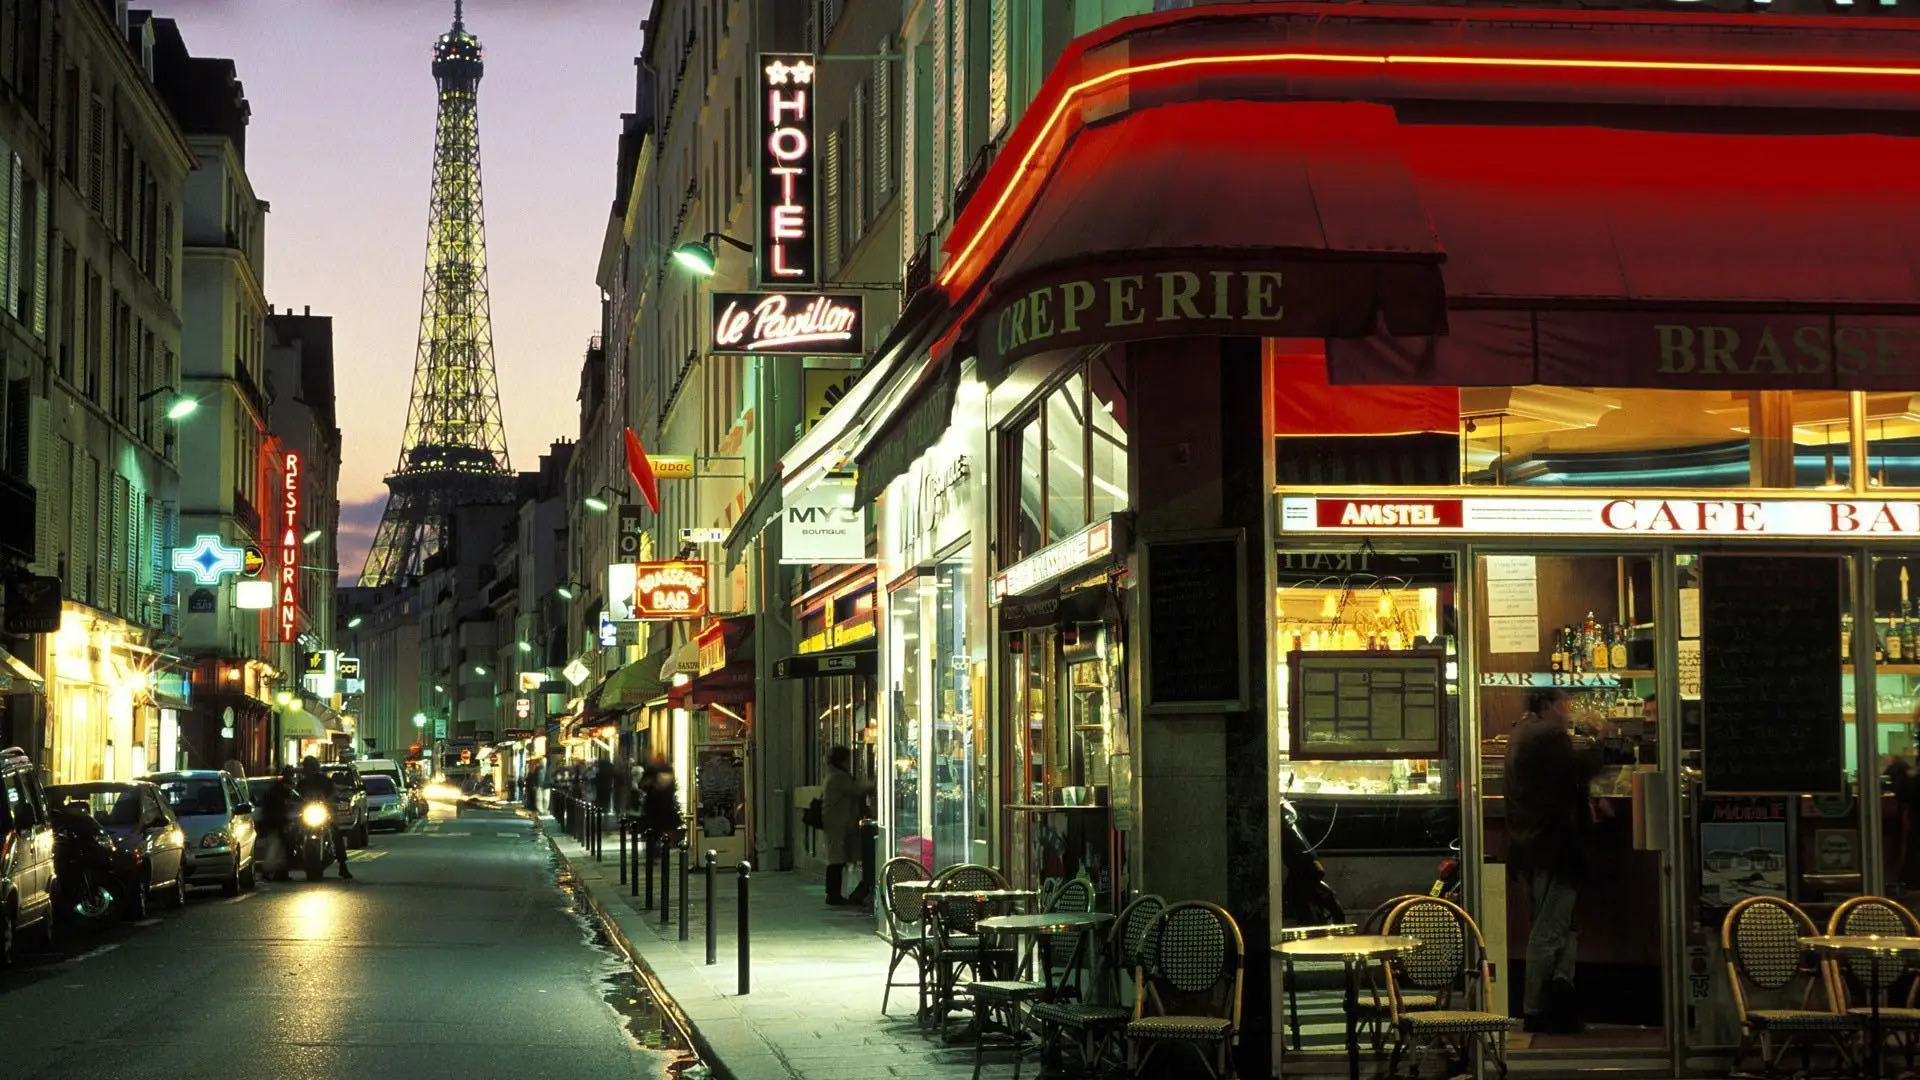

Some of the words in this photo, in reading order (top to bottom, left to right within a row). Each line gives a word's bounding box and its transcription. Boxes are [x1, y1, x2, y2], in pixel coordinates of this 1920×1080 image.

[769, 89, 809, 277] HOTEL
[753, 295, 856, 341] Pavillon
[997, 270, 1284, 356] CREPERIE
[1653, 323, 1920, 375] BRASSE
[1340, 502, 1441, 526] AMSTEL
[1600, 499, 1765, 532] CAFE
[1827, 502, 1920, 532] BA
[283, 453, 298, 642] RESTAURANT
[653, 591, 689, 610] BAR
[1480, 672, 1535, 686] BAR
